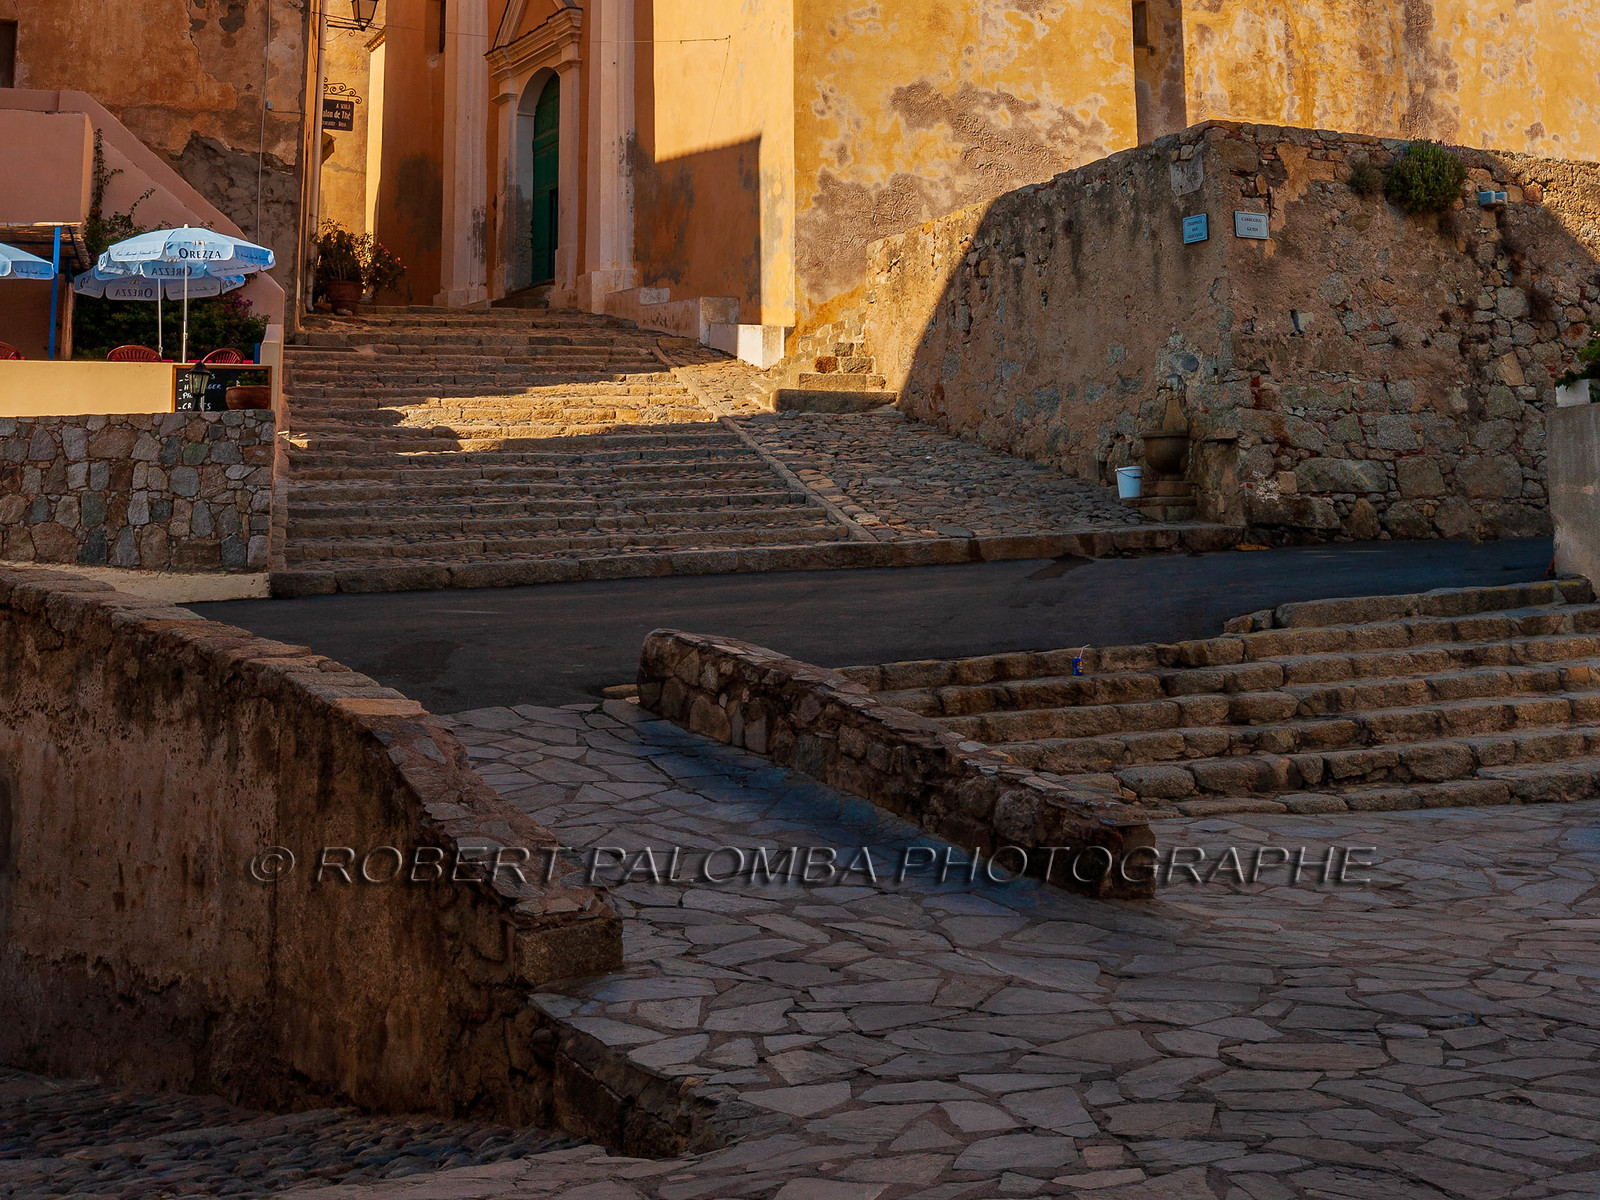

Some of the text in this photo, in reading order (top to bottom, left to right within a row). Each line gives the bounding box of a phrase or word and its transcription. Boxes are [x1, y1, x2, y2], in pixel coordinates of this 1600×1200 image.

[323, 109, 333, 118] alon
[334, 110, 341, 119] de
[178, 247, 222, 259] OREZZA
